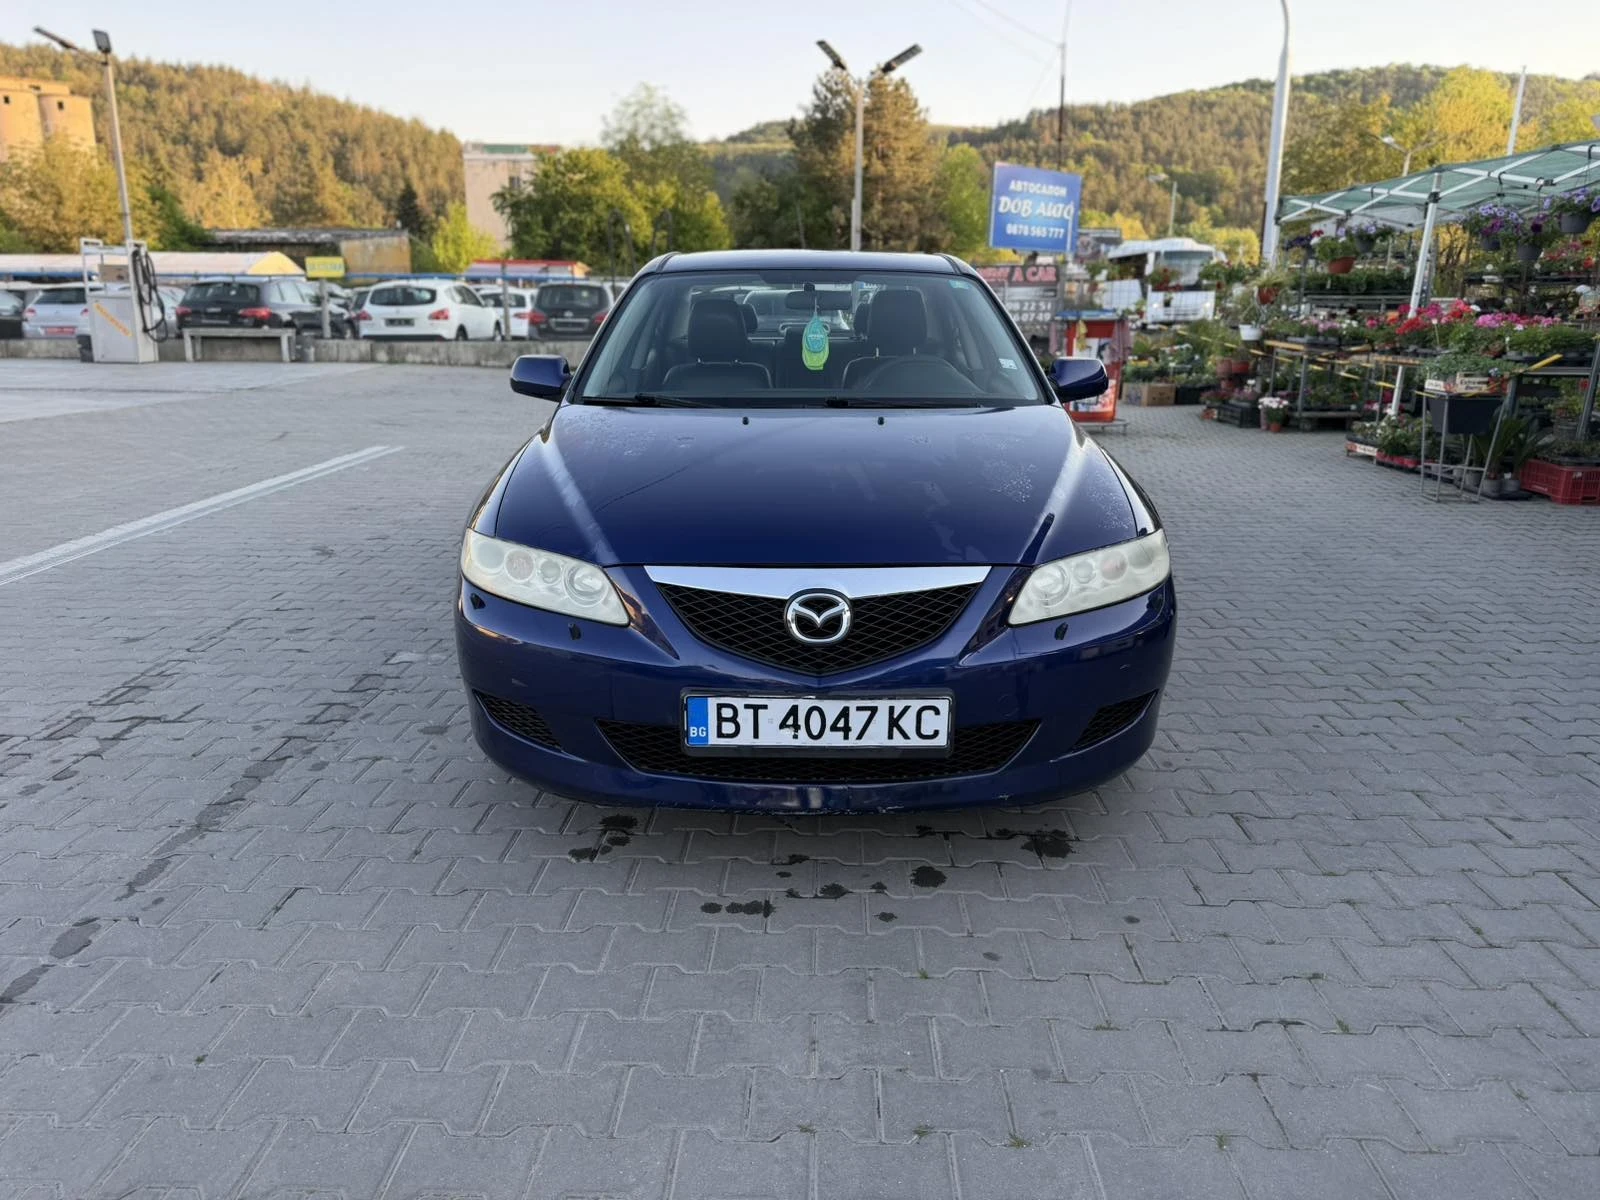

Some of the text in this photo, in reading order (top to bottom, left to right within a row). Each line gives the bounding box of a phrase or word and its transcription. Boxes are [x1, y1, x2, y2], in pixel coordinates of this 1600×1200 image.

[1012, 267, 1025, 282] A
[1026, 266, 1057, 282] CAR
[715, 702, 941, 741] BT 4047 KC
[689, 726, 707, 737] BG
